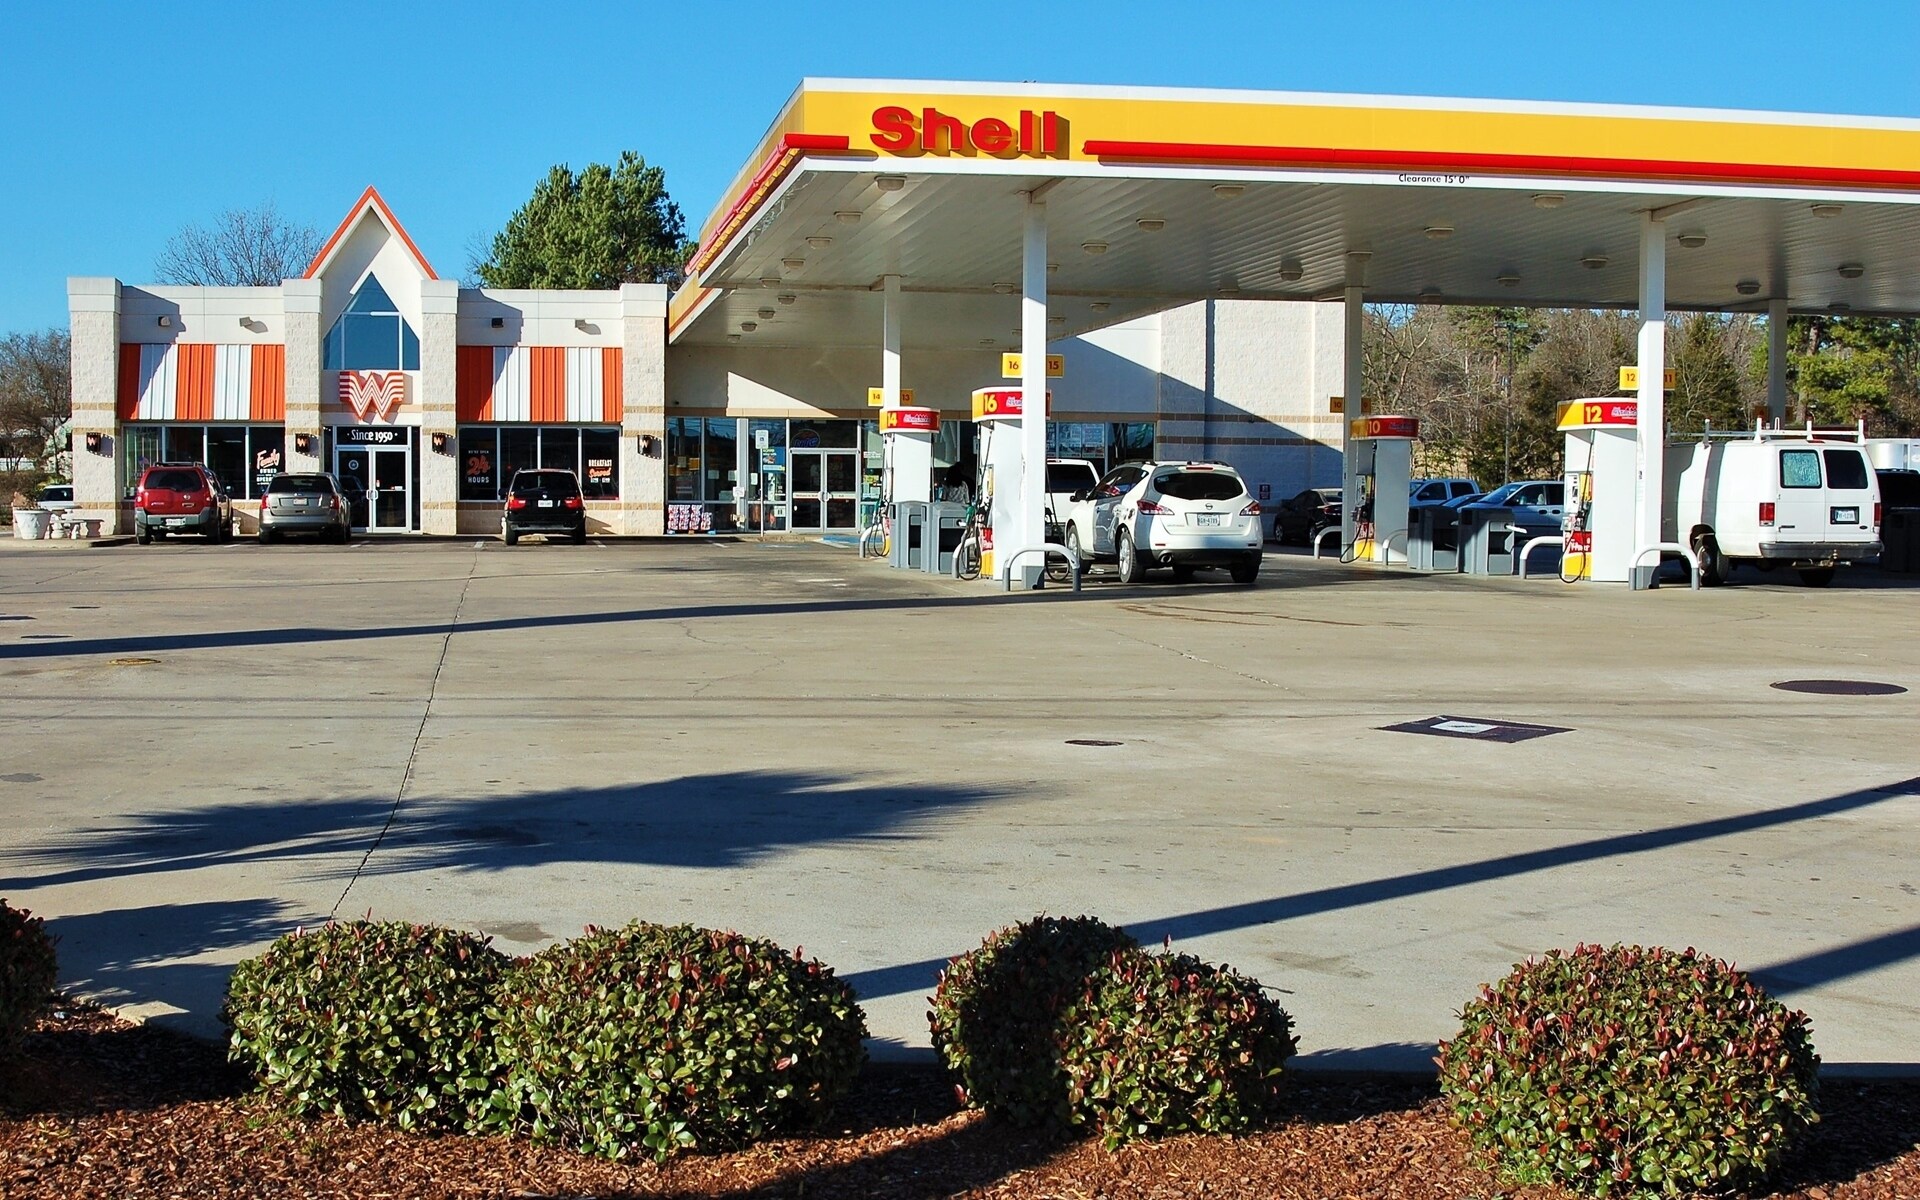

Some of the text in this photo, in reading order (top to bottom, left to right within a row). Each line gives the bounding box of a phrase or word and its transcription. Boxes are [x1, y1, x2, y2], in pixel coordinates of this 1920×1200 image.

[870, 106, 1057, 154] Shell
[1398, 173, 1442, 183] Clearance
[1444, 174, 1456, 183] 15'
[1009, 361, 1019, 370] 16
[1048, 361, 1059, 370] 15
[1626, 374, 1636, 382] 12
[339, 371, 404, 421] W
[984, 394, 998, 413] 16
[887, 412, 898, 427] 14
[1585, 405, 1602, 423] 12
[1369, 420, 1381, 434] 10
[351, 429, 393, 443] Since 1950
[466, 455, 491, 476] 24
[588, 459, 612, 467] BREAKFAST
